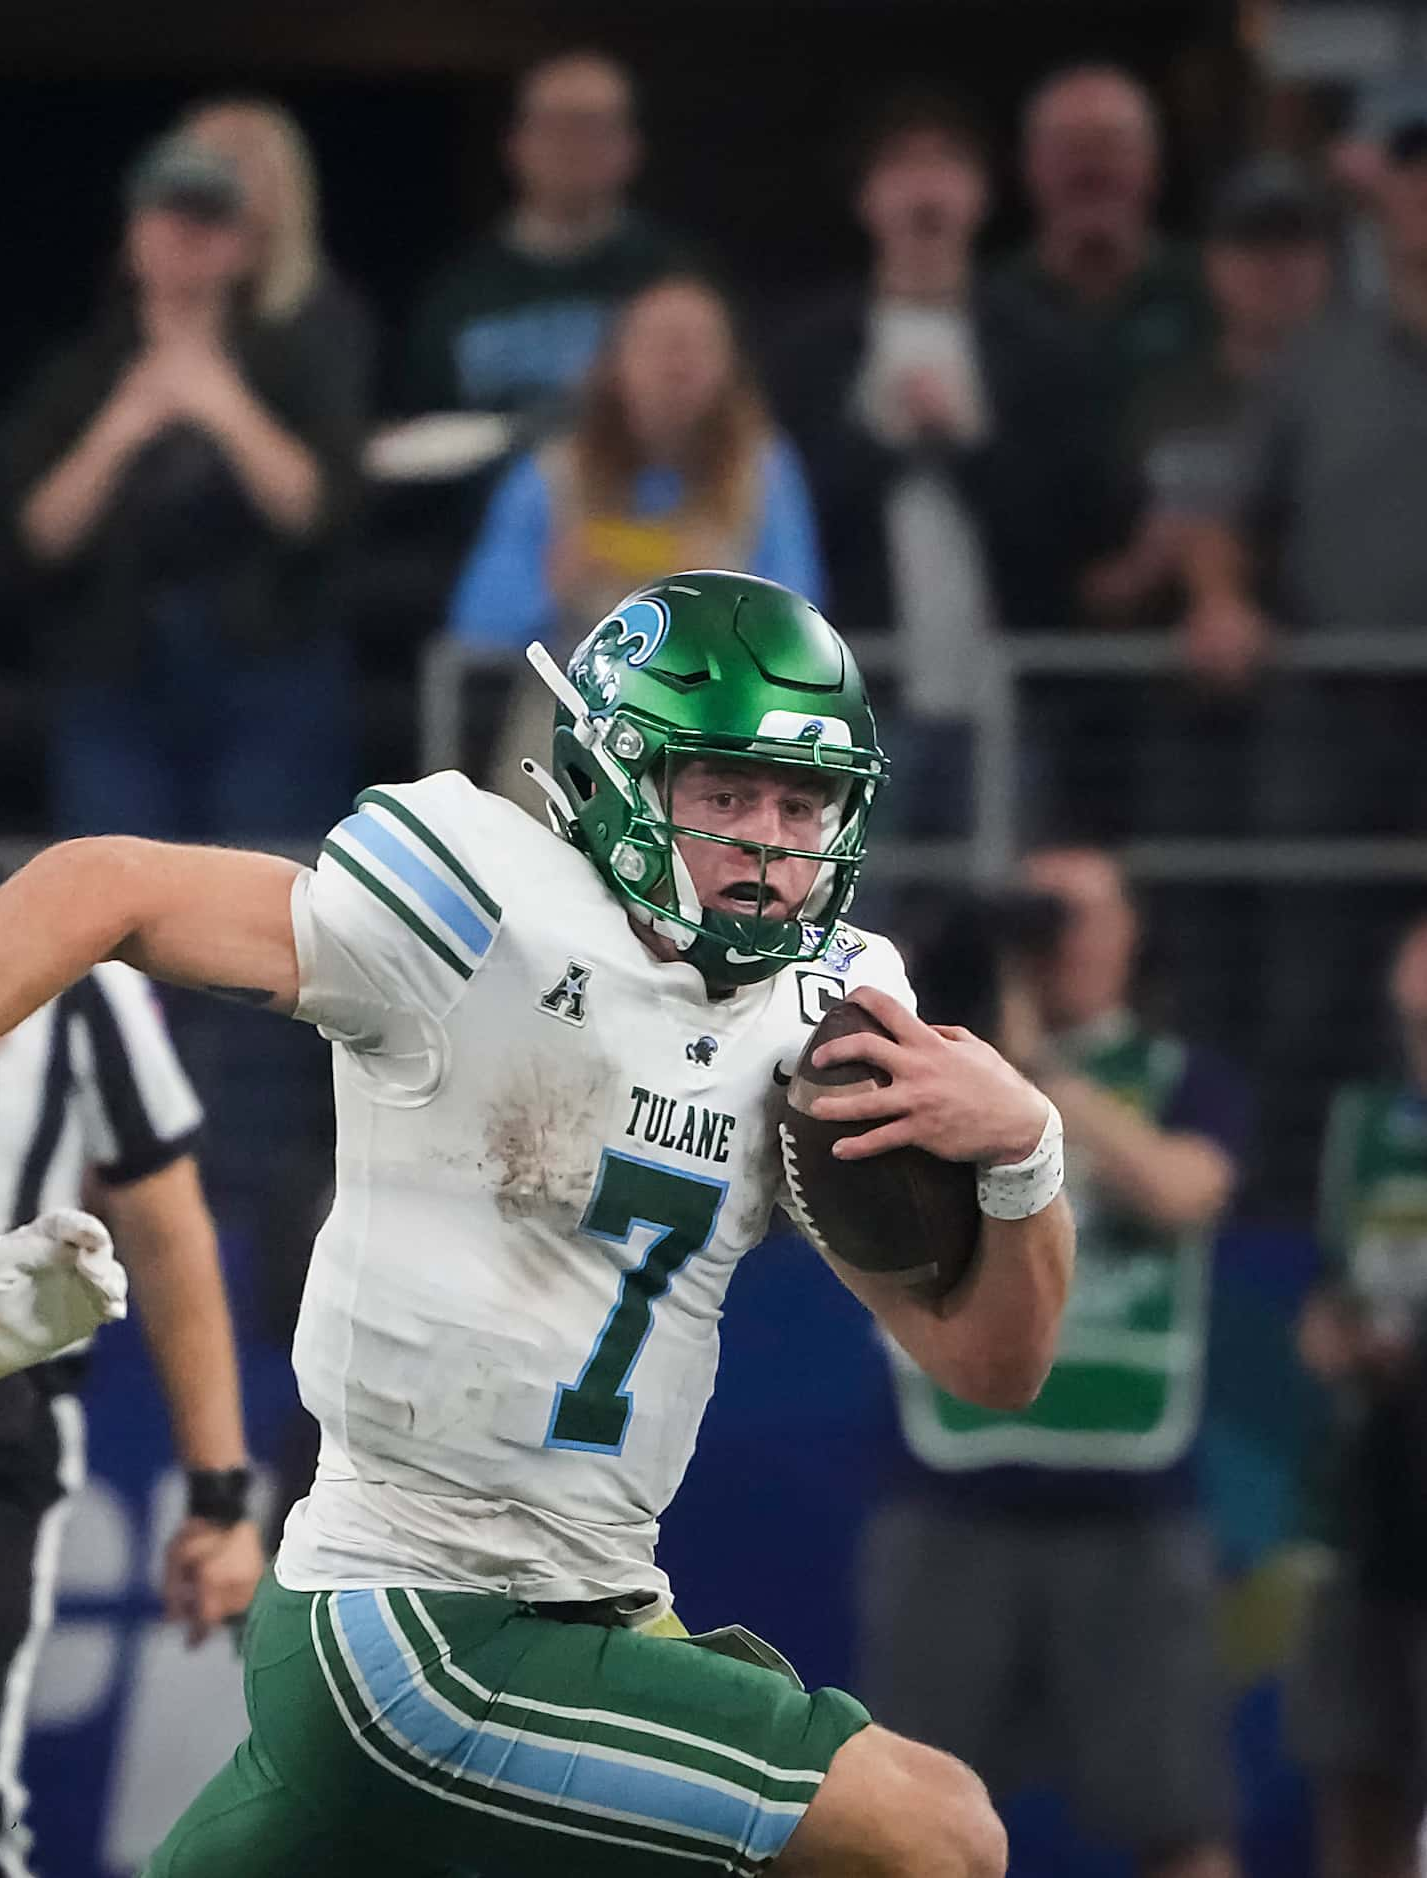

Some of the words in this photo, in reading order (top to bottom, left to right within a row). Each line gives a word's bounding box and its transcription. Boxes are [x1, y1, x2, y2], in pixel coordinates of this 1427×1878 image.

[538, 960, 595, 1023] A
[800, 974, 844, 1023] C
[626, 1086, 736, 1163] TULANE
[544, 1146, 730, 1457] 7
